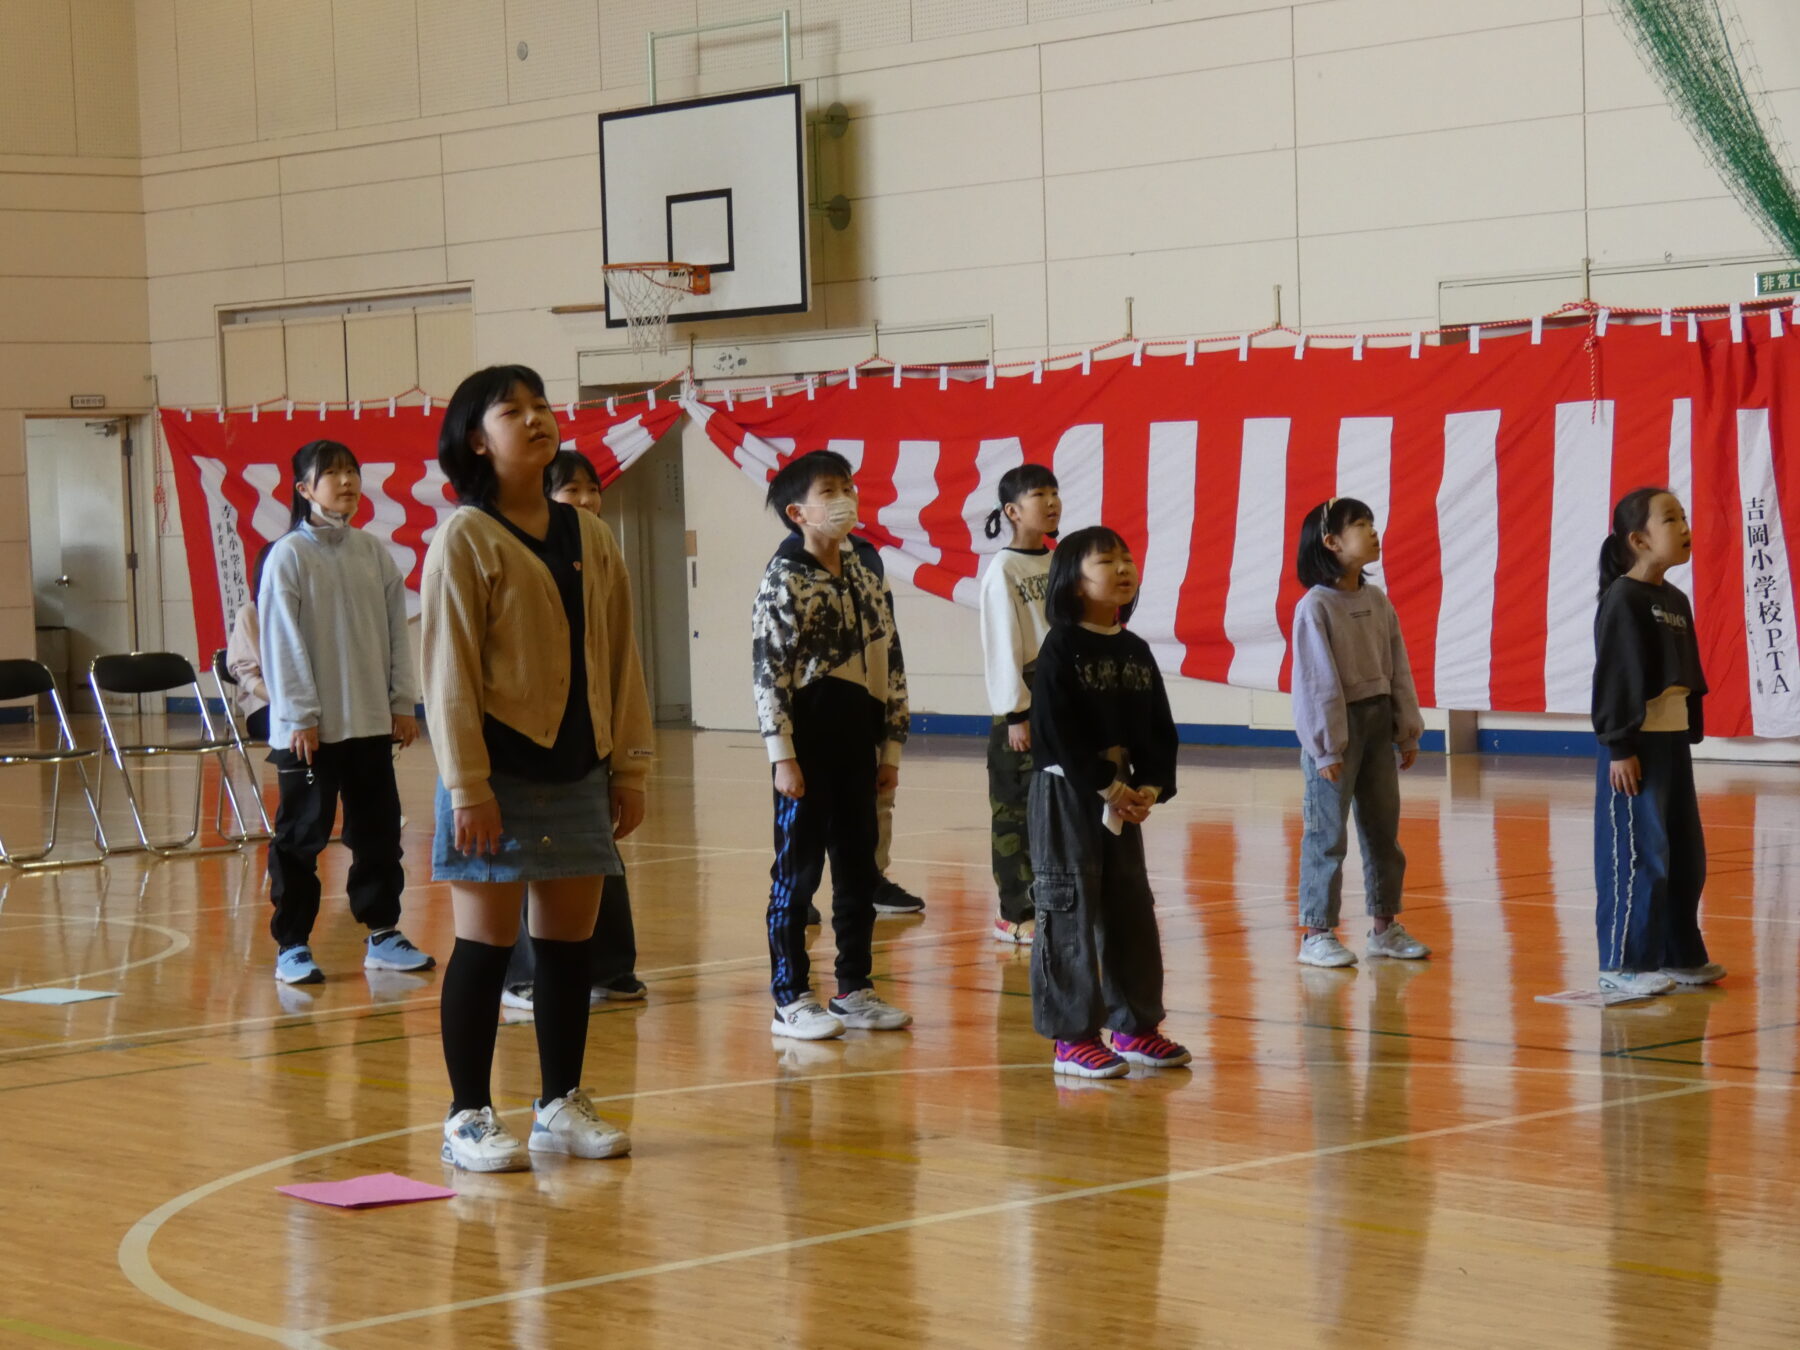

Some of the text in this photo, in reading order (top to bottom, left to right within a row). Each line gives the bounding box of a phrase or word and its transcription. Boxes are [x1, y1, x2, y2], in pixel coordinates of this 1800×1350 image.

[1745, 497, 1791, 694] 吉岡小学校PTA
